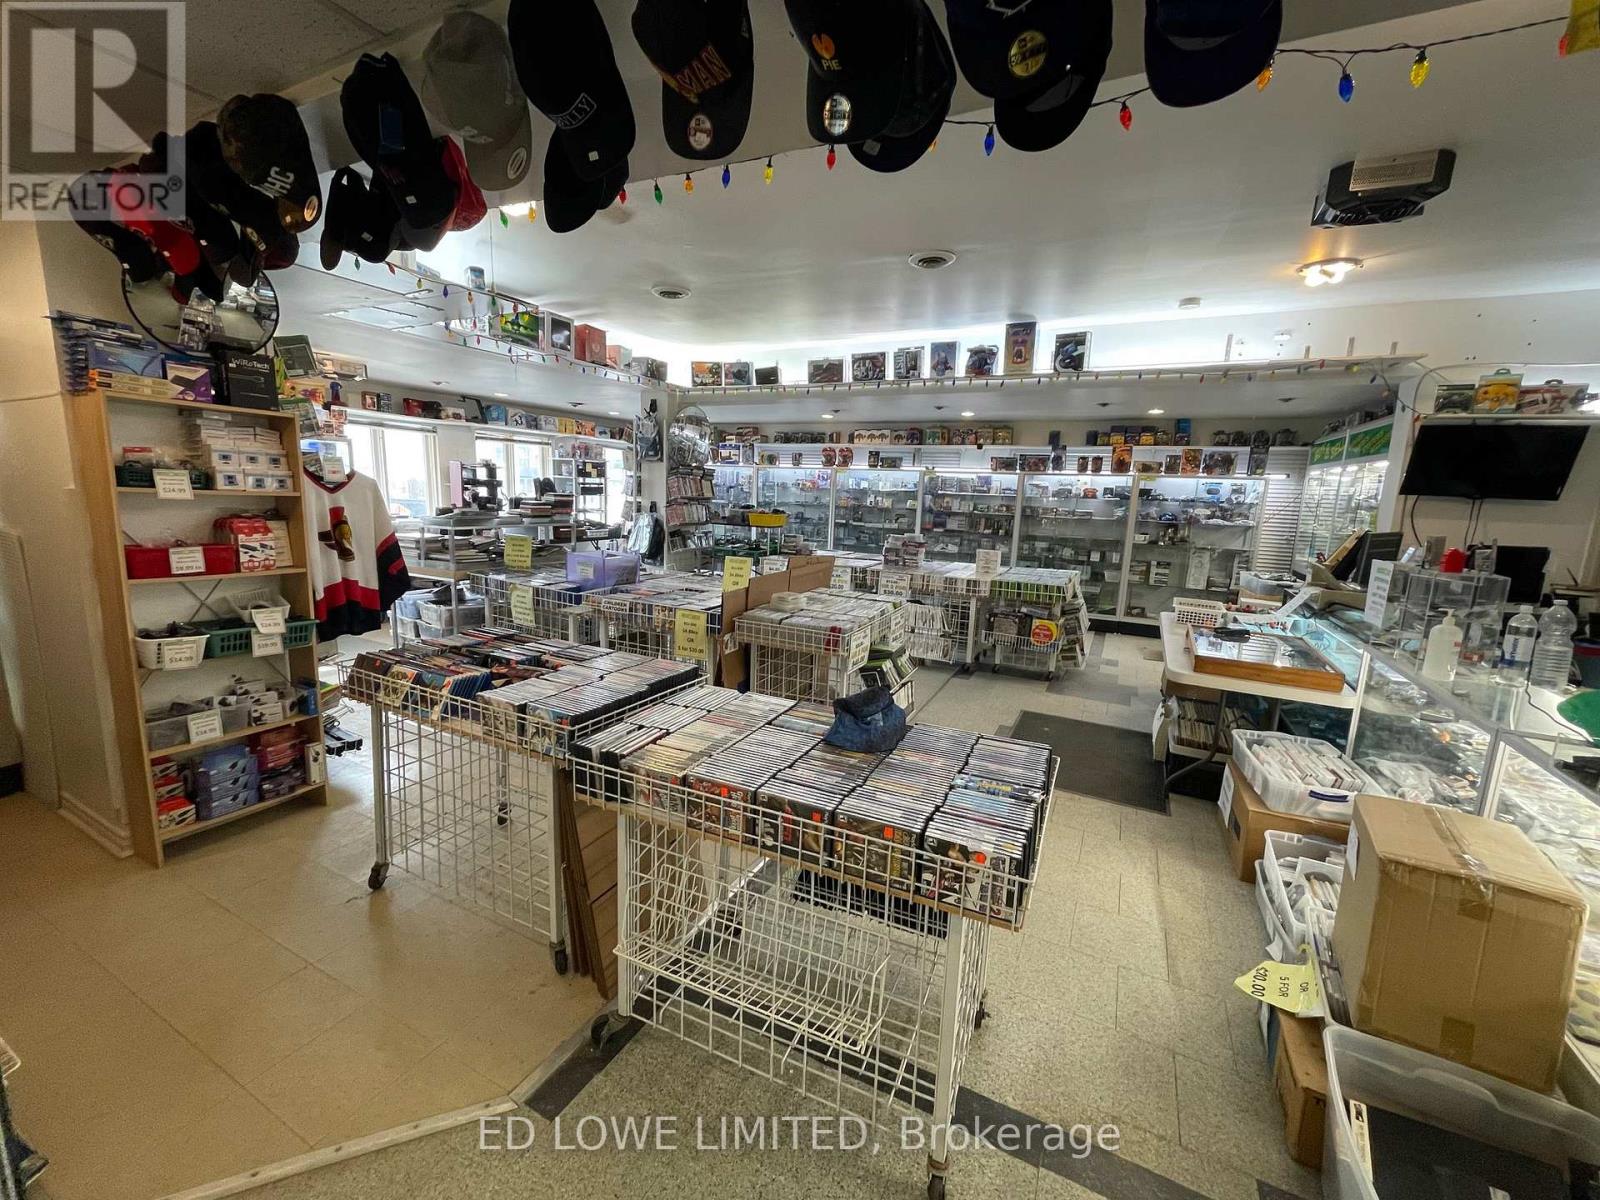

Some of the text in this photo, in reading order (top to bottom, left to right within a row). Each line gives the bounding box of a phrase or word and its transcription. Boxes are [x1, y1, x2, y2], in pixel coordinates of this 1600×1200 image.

[820, 59, 843, 71] PIE
[231, 357, 270, 370] WiRoTech
[1250, 965, 1269, 998] $20.00
[1299, 981, 1310, 993] OR
[1278, 983, 1290, 998] FOR
